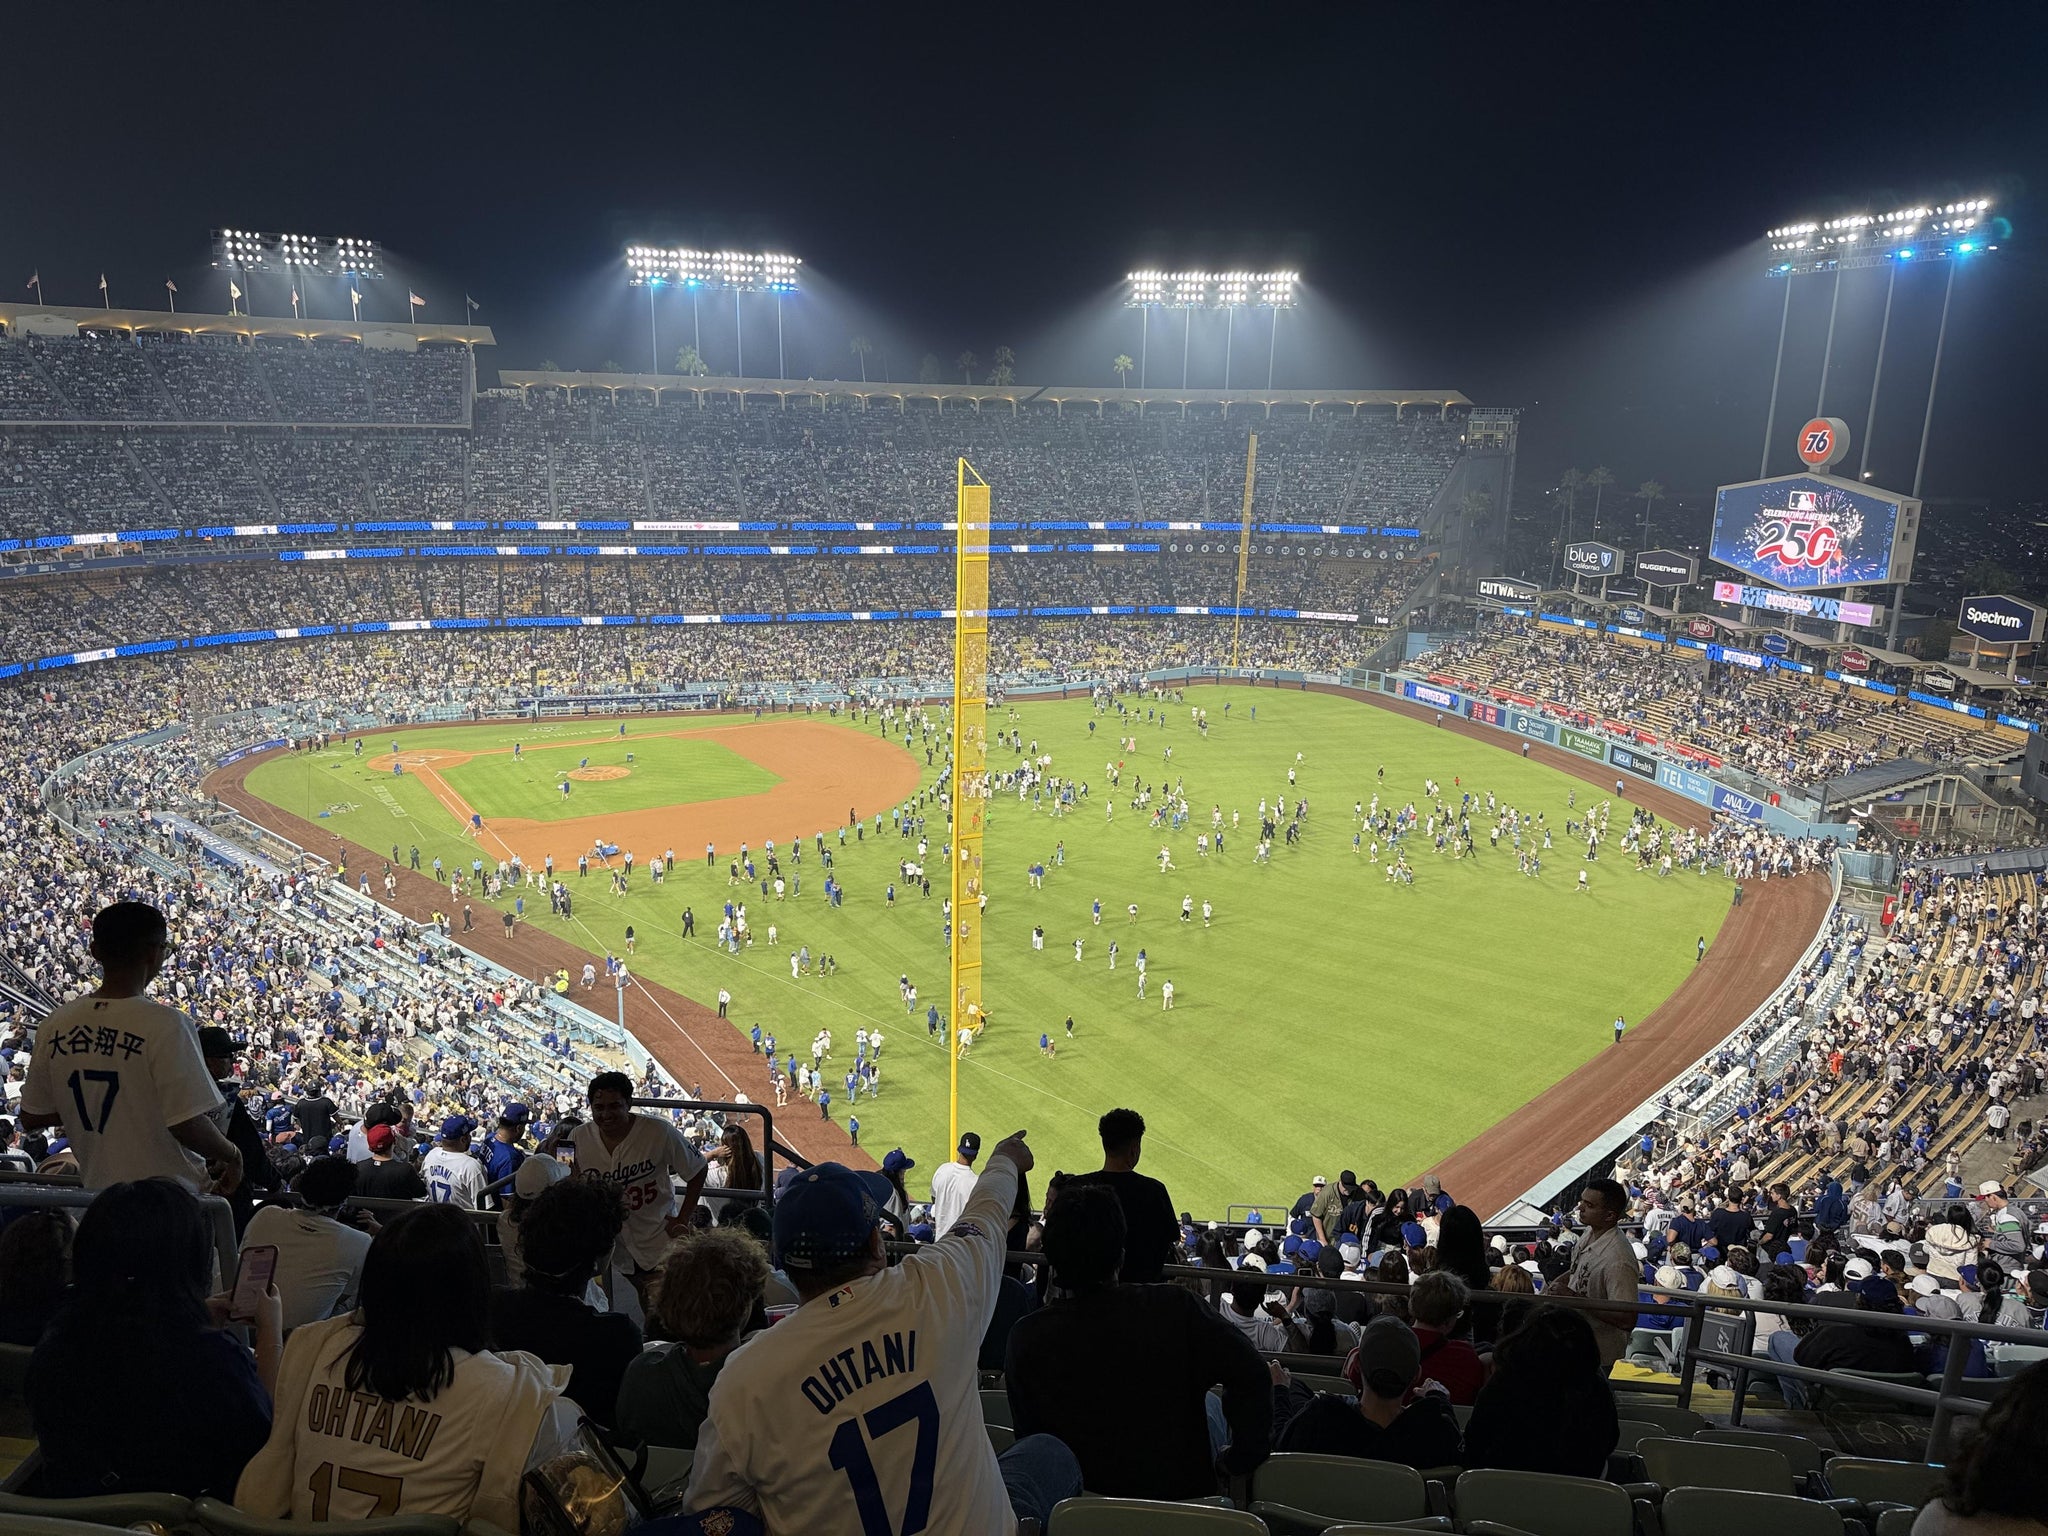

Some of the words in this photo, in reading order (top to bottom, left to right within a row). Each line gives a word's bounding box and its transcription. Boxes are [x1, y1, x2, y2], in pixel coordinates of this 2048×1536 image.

[1804, 430, 1830, 454] 76
[1763, 508, 1804, 521] CELEBRATING
[1804, 511, 1840, 523] AMERICA'S
[1569, 547, 1598, 564] blue
[1572, 563, 1600, 572] california
[1639, 562, 1687, 575] GUGGENHEIM
[1766, 593, 1812, 612] DODGERS
[1693, 623, 1710, 632] JINRO
[1966, 607, 2021, 629] Spectrum
[1722, 649, 1762, 668] DODGERS
[1843, 654, 1867, 667] Yakult
[1415, 686, 1451, 706] DODGERS
[1528, 727, 1545, 738] Benefit
[1529, 719, 1548, 732] Security
[1615, 753, 1630, 763] UCLA
[1632, 757, 1653, 774] Health
[1662, 766, 1684, 790] TEL
[1688, 776, 1700, 787] TOKYO
[1722, 792, 1743, 809] ANA
[48, 1024, 146, 1061] 大谷翔平
[68, 1069, 120, 1135] 17
[430, 1165, 453, 1181] OHTANI
[579, 1159, 656, 1187] Dodgers
[430, 1180, 452, 1204] 17
[627, 1180, 658, 1211] 35
[1660, 1220, 1669, 1232] 17
[801, 1329, 917, 1416] OHTANI
[308, 1383, 442, 1462] OHTANI
[827, 1379, 940, 1536] 17
[308, 1461, 403, 1523] 17
